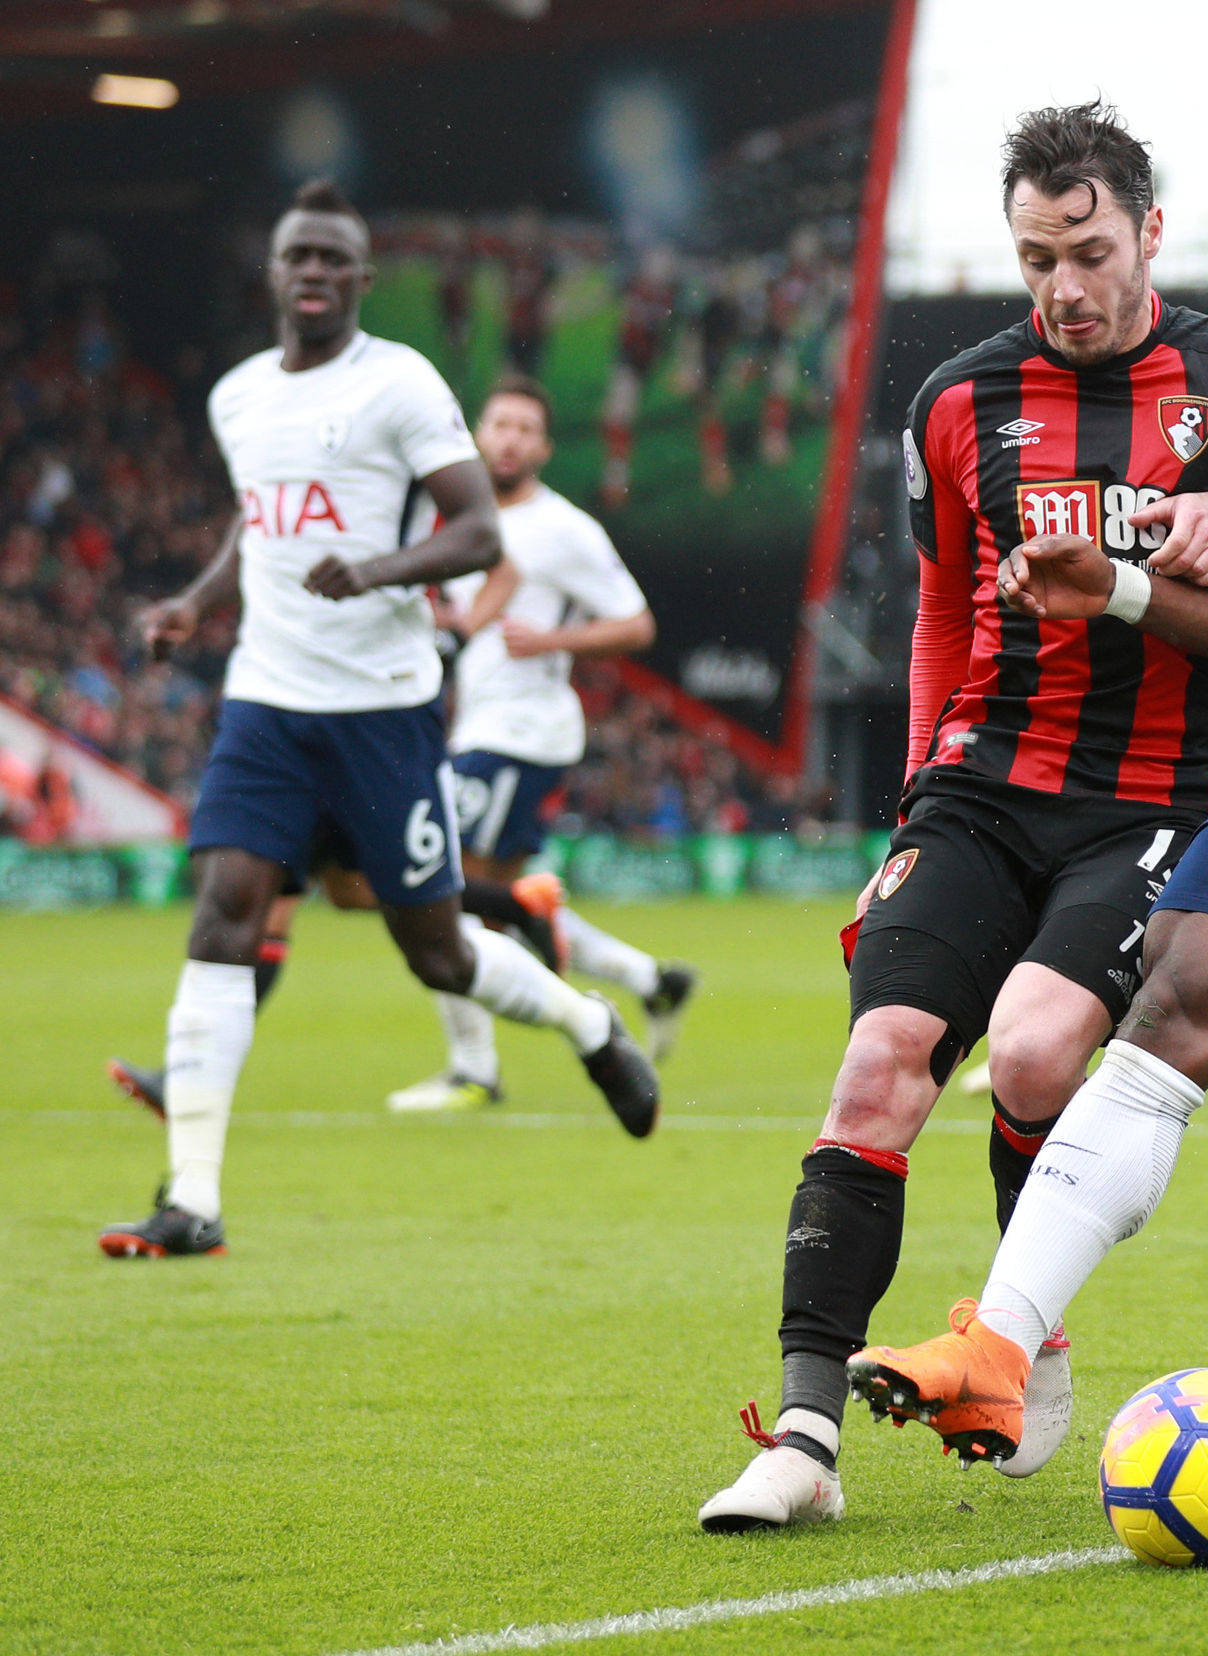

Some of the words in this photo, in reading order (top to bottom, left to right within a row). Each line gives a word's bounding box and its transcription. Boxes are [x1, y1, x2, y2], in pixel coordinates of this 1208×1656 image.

[1001, 436, 1041, 449] umbro
[239, 482, 345, 537] AIA
[404, 798, 446, 865] 6
